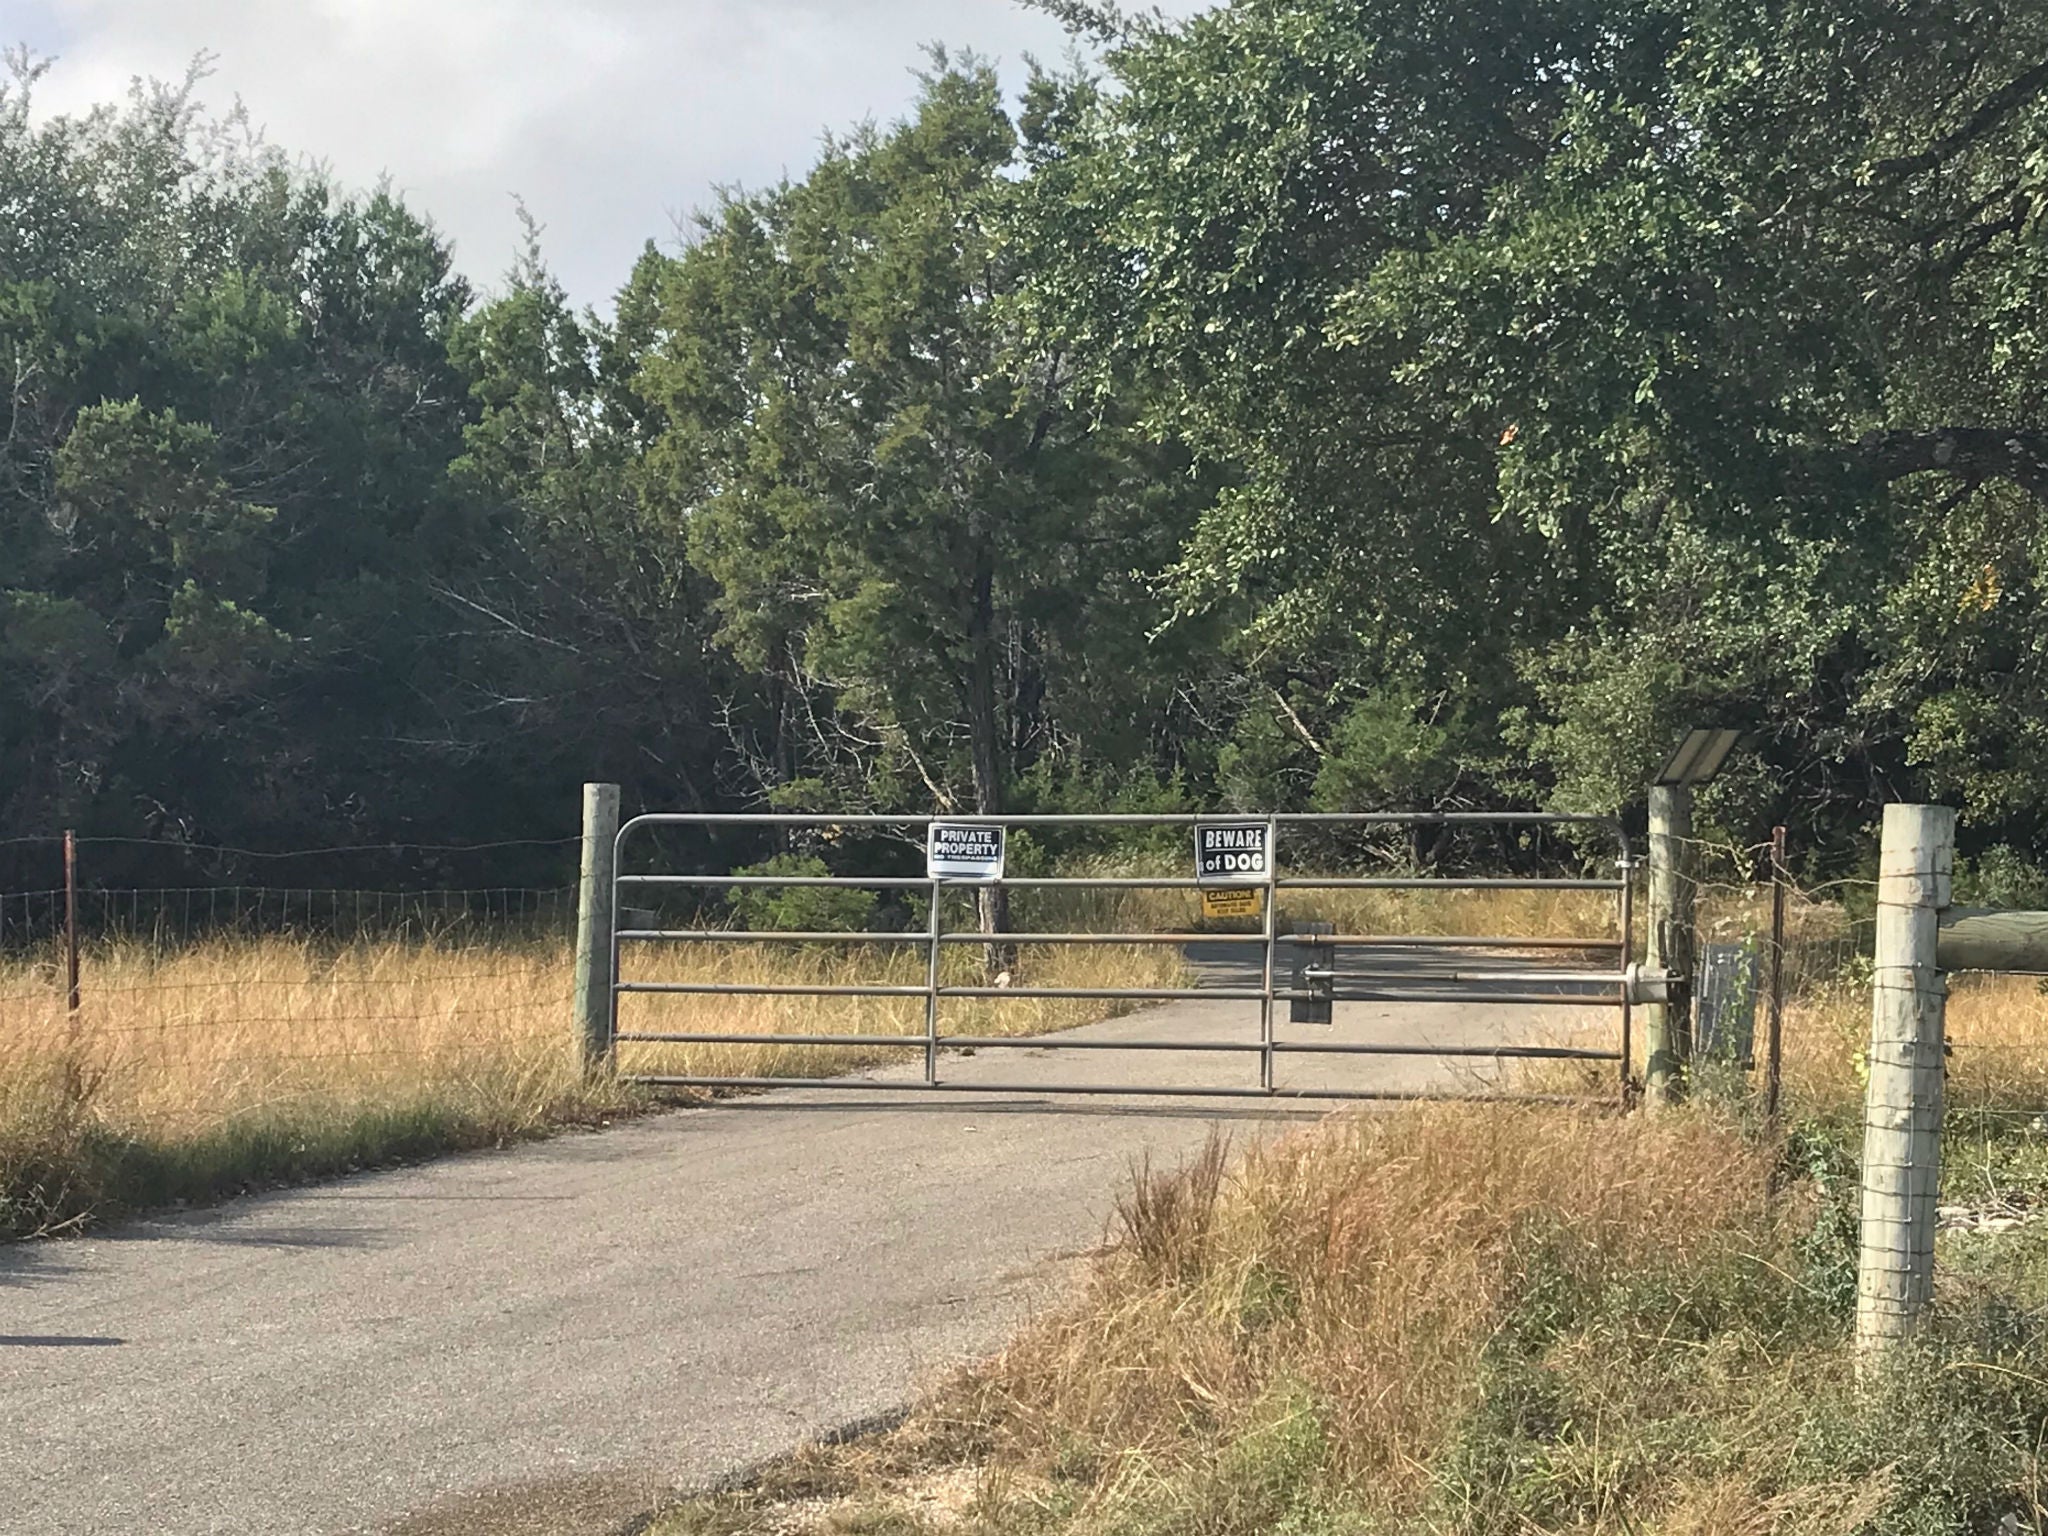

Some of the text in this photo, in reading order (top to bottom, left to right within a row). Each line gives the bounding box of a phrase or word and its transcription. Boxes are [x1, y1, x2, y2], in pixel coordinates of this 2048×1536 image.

[941, 830, 992, 843] PRIVATE
[1206, 829, 1262, 848] BEWARE
[934, 842, 998, 855] PROPERTY
[1206, 853, 1263, 871] of DOG
